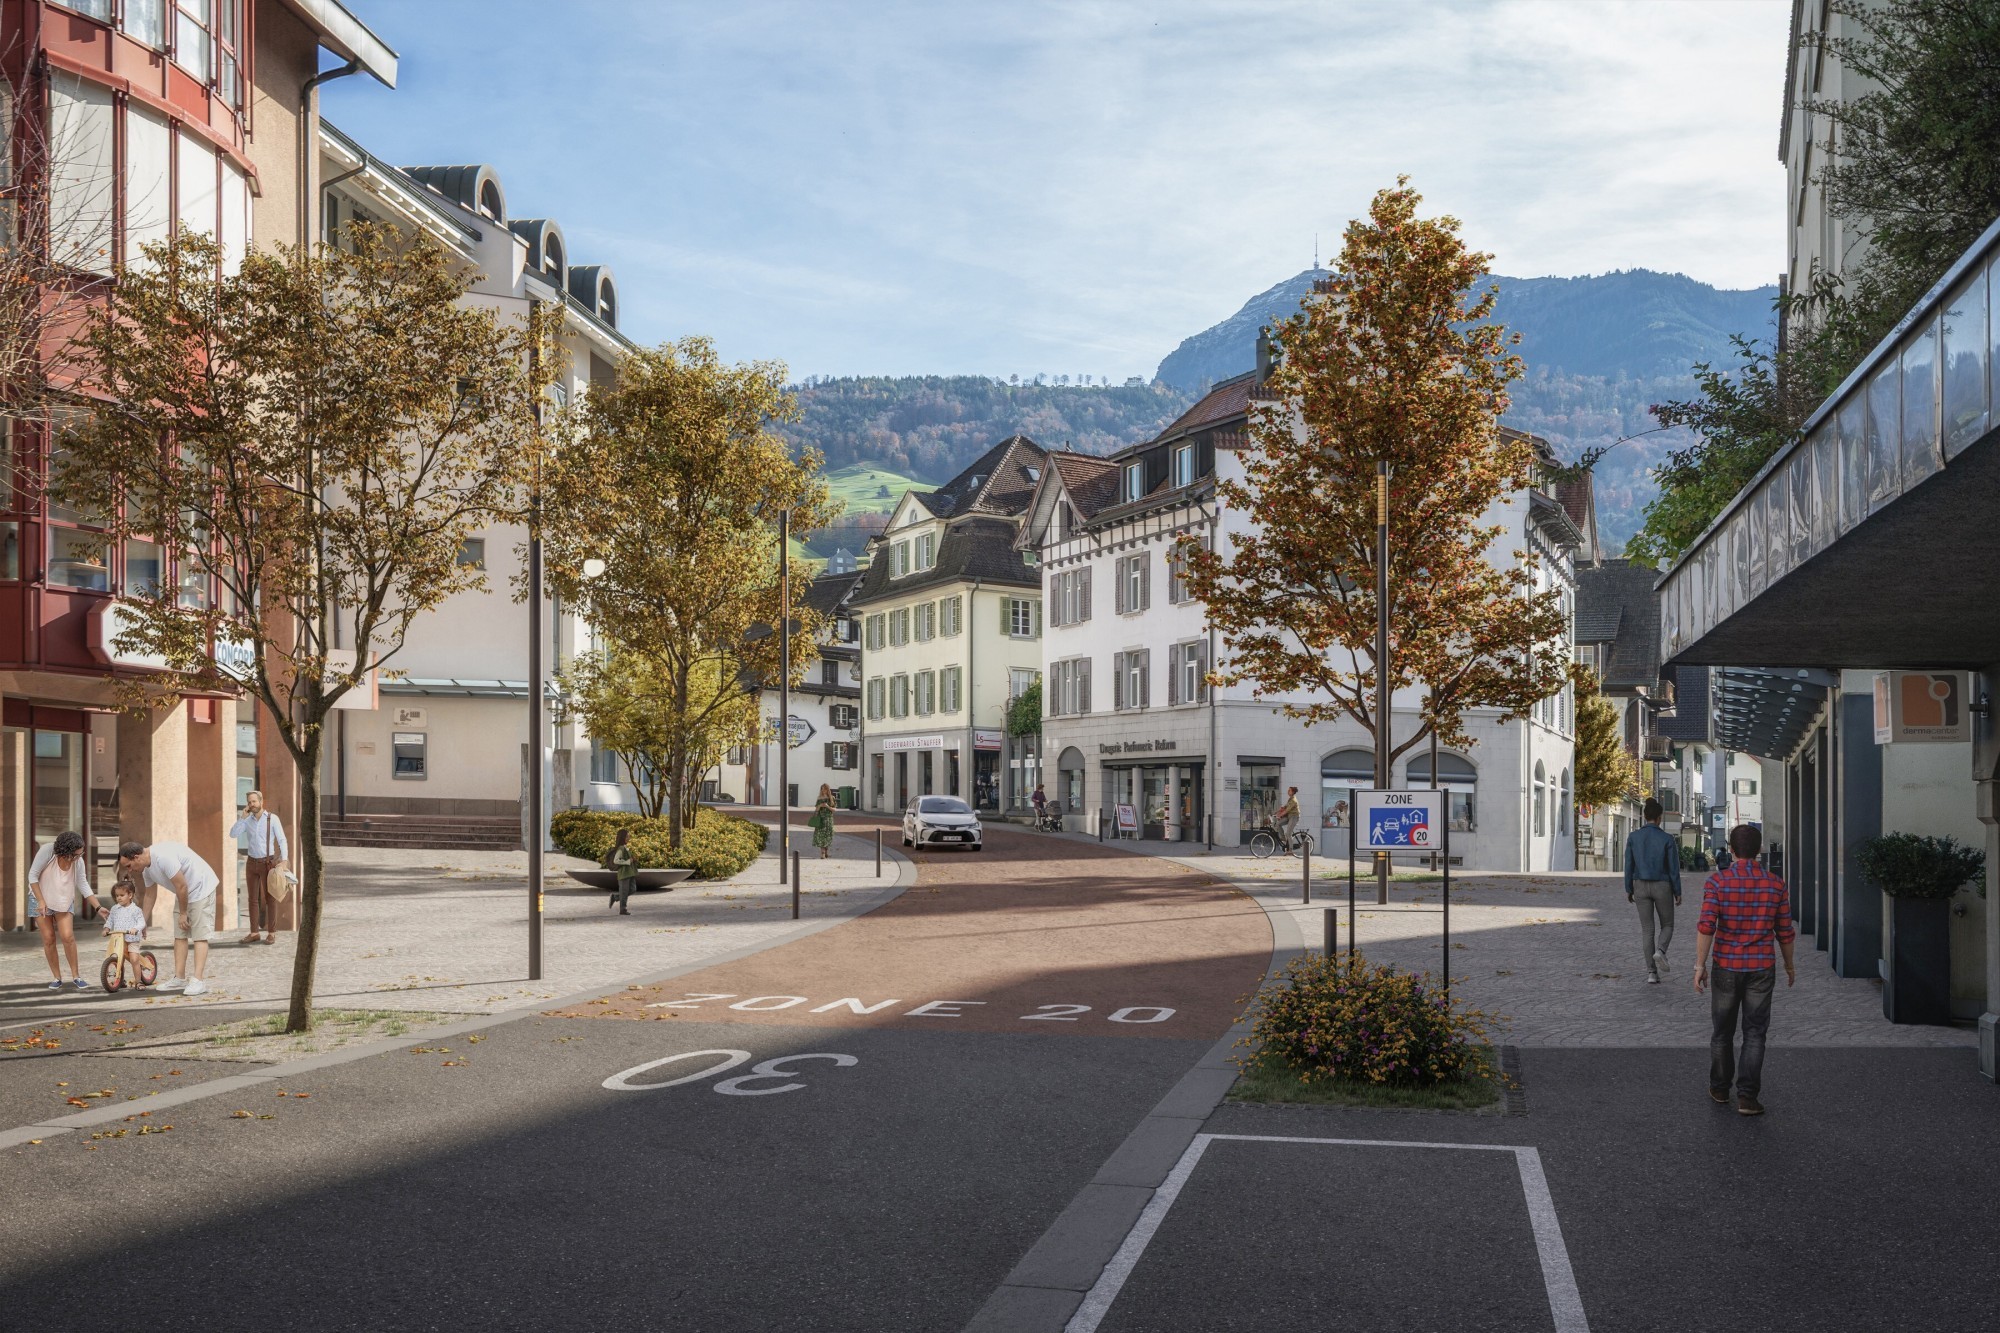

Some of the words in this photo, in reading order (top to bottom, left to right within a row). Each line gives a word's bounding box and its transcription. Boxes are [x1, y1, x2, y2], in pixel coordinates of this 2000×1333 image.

[1902, 727, 1960, 735] dermacenter
[1384, 794, 1413, 804] ZONE
[1416, 831, 1427, 841] 20
[644, 993, 987, 1018] ZONE
[1019, 1003, 1177, 1024] 20
[601, 1049, 859, 1096] 30
